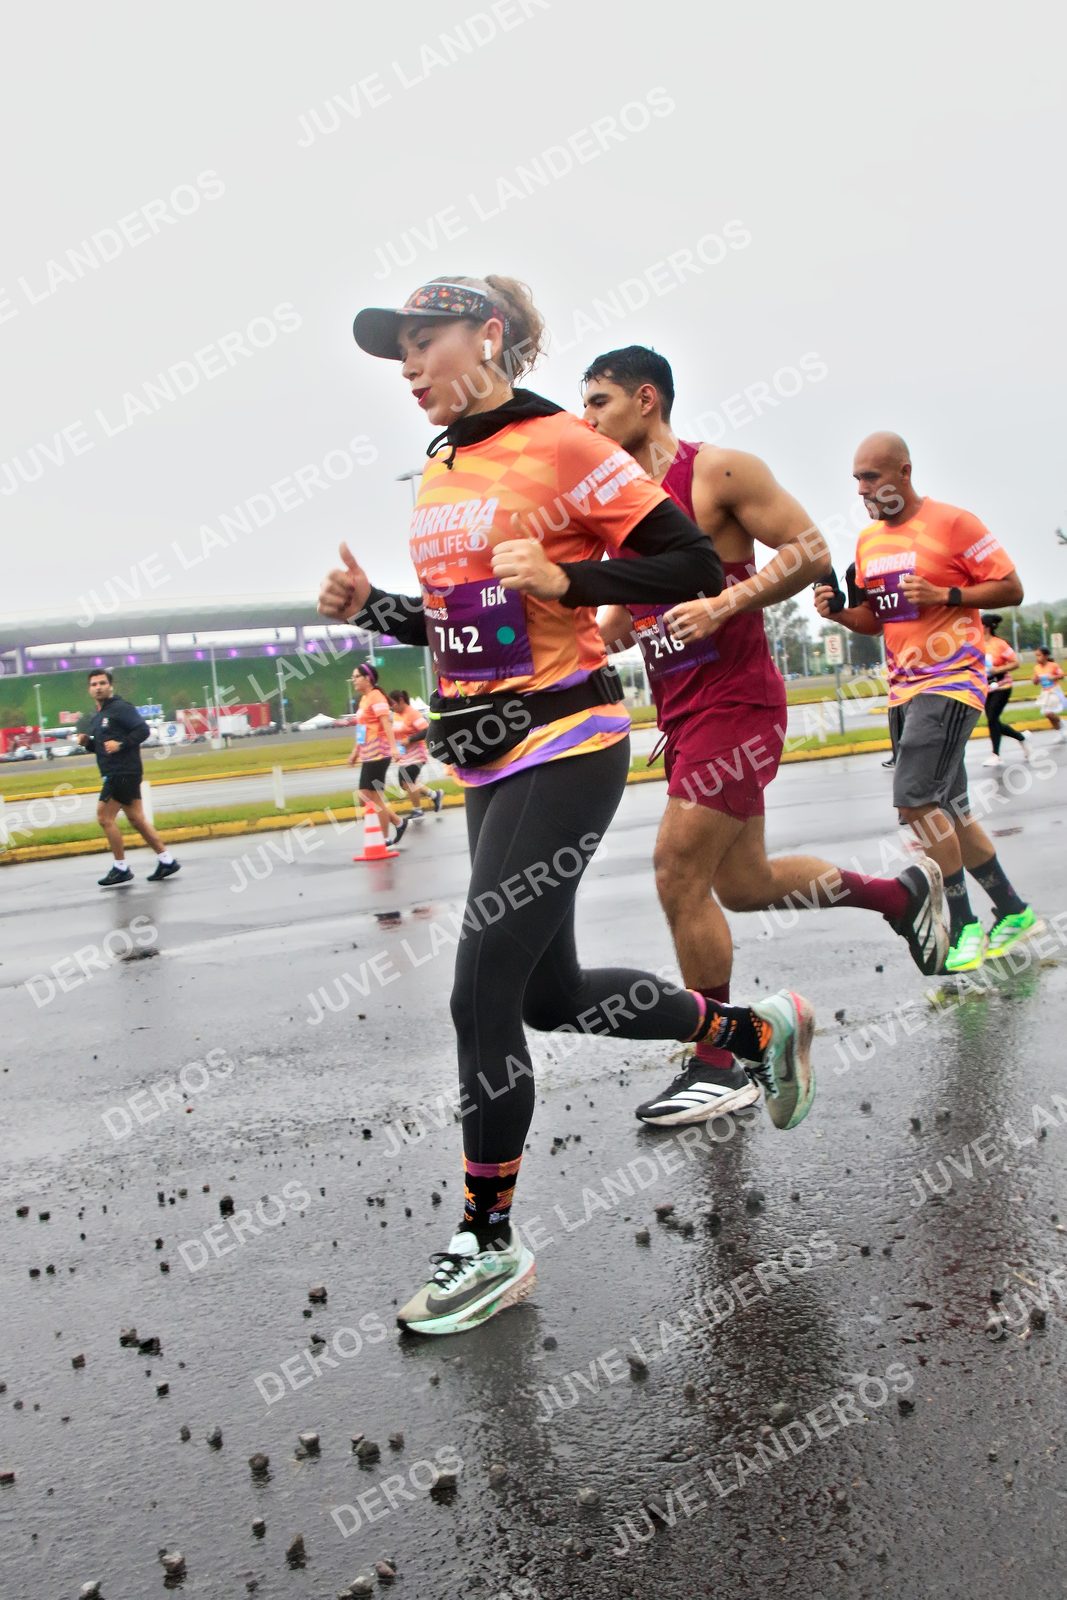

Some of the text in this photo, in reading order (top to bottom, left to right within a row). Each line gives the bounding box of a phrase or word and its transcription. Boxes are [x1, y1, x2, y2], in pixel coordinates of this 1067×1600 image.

[410, 534, 464, 564] MNILIFE
[480, 586, 508, 608] 15K
[877, 593, 899, 610] 217
[434, 625, 483, 654] 742
